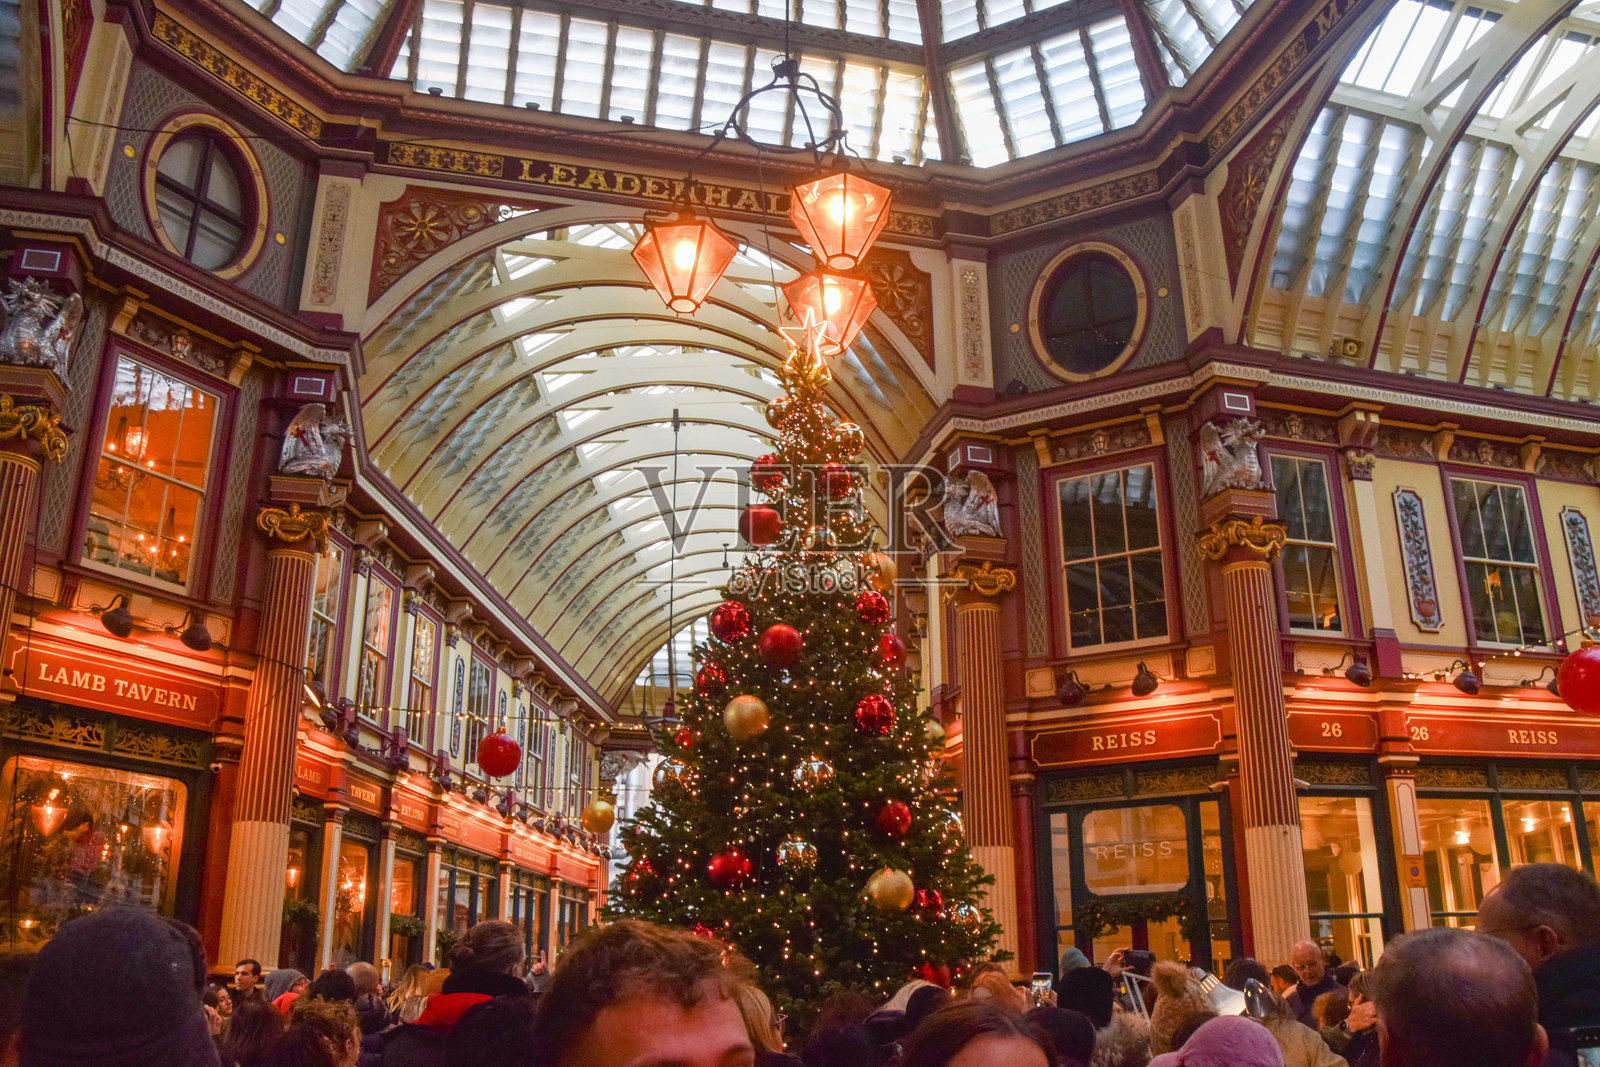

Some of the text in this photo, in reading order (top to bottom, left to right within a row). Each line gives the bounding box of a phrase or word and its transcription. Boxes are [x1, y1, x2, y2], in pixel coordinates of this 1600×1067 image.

[518, 159, 791, 215] LEADENHAL
[38, 662, 198, 712] LAMB TAVERN
[1321, 722, 1342, 738] 26
[1410, 726, 1558, 745] 26 REISS
[1092, 730, 1156, 751] REISS
[297, 766, 321, 784] LAMB
[350, 785, 376, 804] TAVERN
[1096, 841, 1172, 860] REISS
